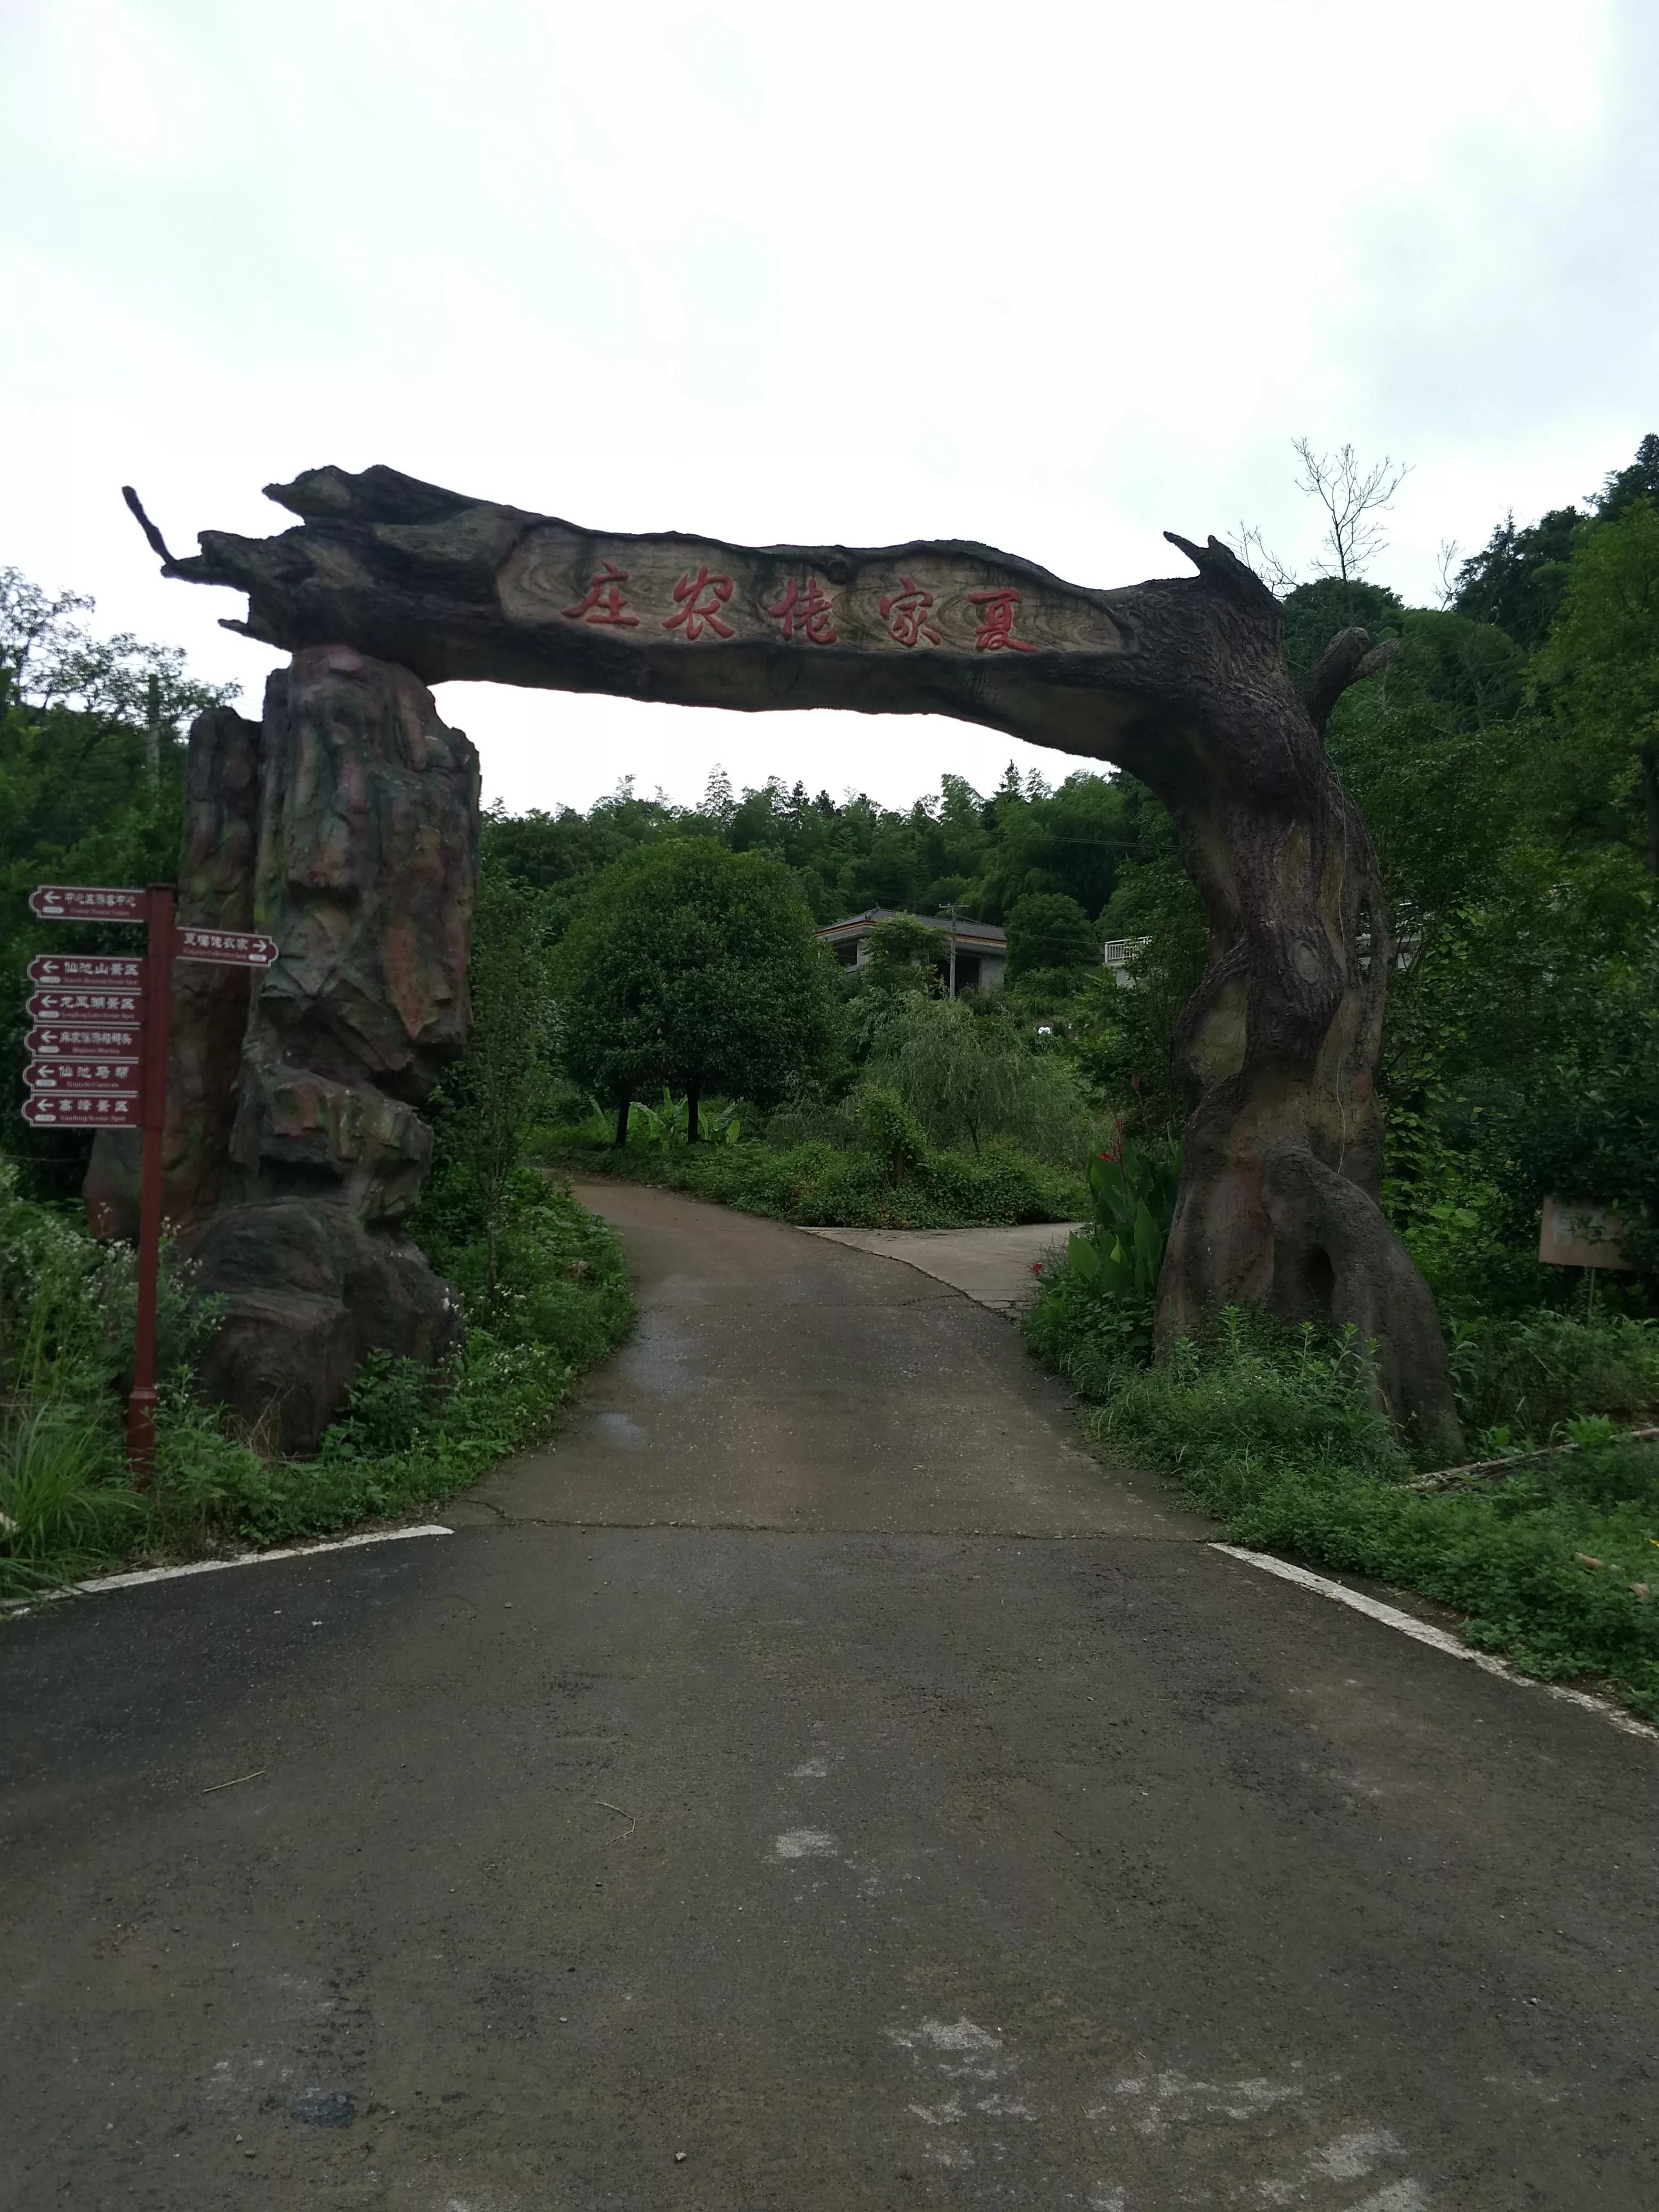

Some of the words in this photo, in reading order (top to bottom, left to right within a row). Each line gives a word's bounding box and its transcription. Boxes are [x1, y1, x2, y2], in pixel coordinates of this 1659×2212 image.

[64, 961, 140, 976] 仙池山景区
[58, 1099, 129, 1113] 高峰景区
